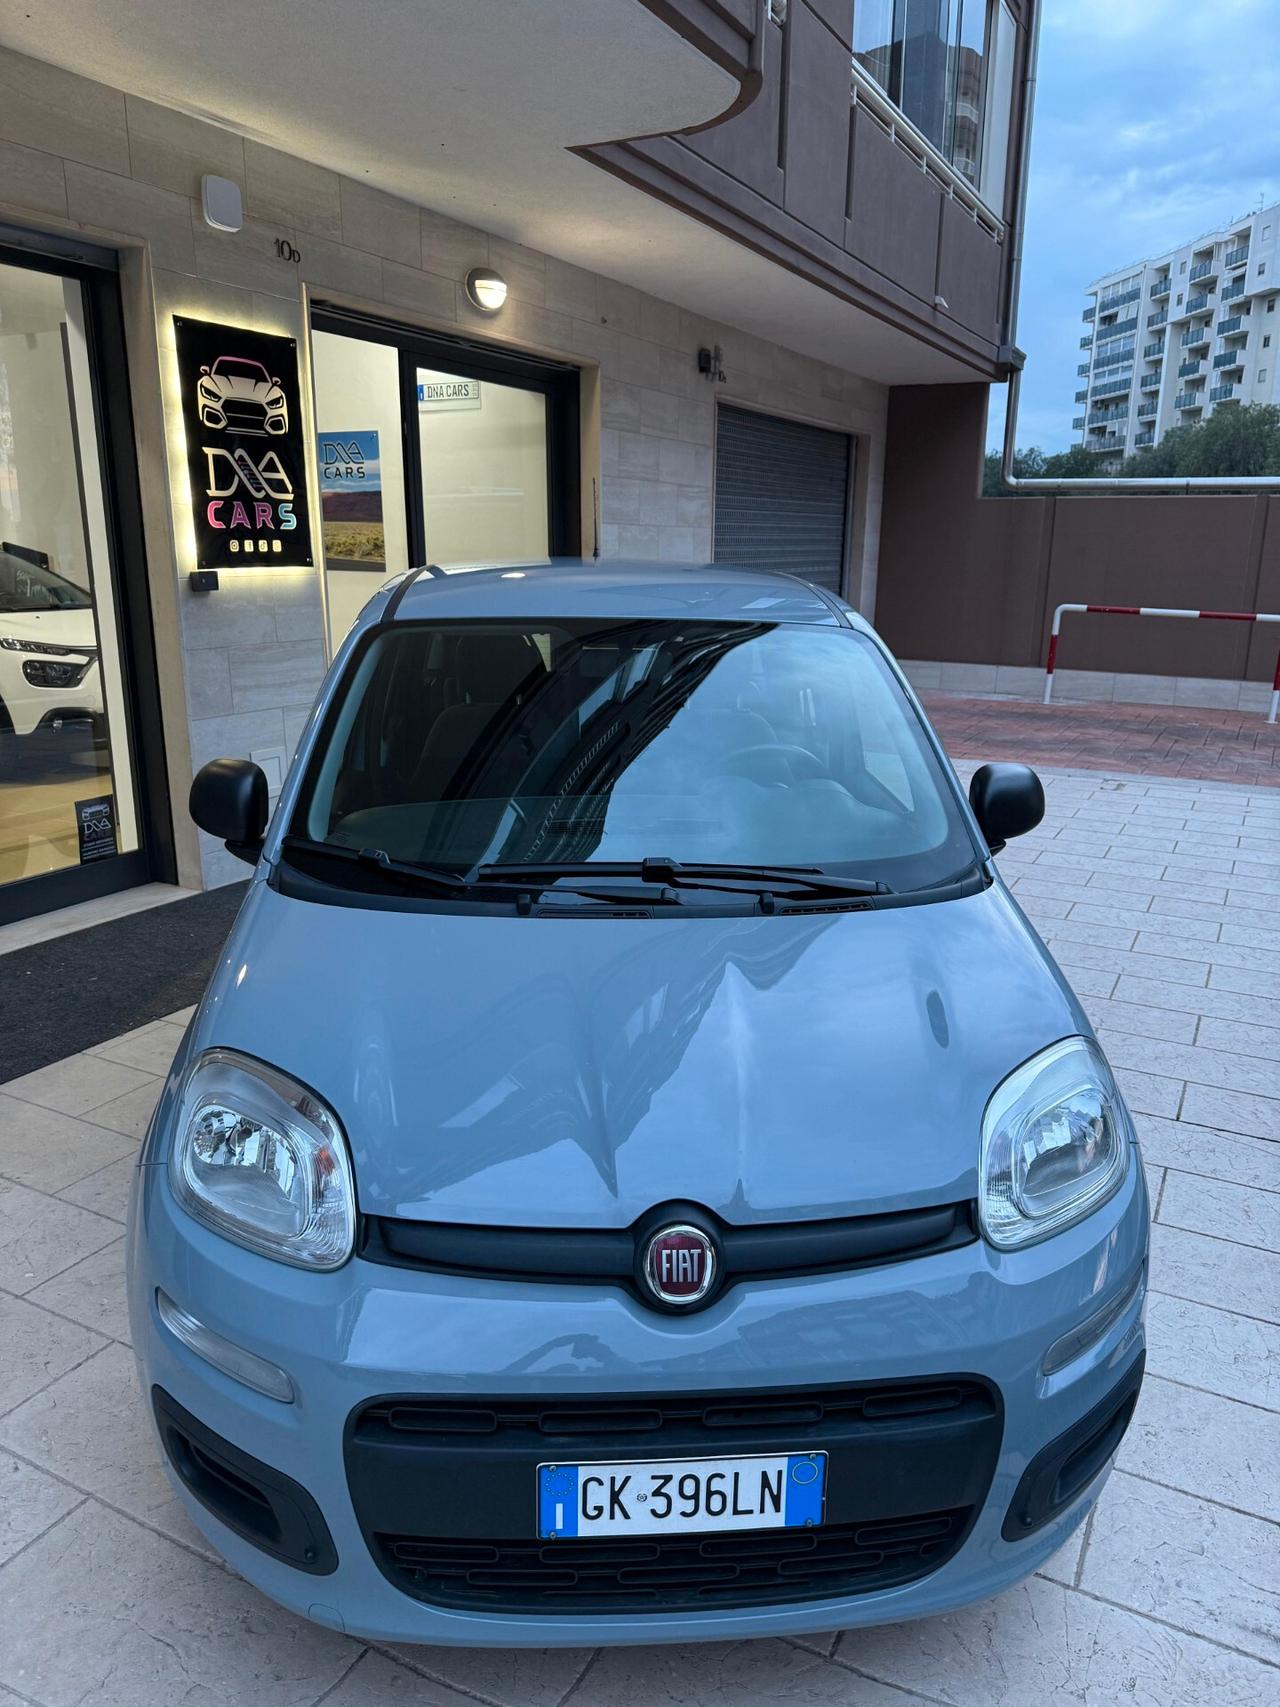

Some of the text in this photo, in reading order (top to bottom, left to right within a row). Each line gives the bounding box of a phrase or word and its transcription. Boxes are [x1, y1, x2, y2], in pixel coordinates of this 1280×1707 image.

[427, 386, 444, 398] DNA
[446, 384, 469, 398] CARS
[323, 441, 364, 465] DNA
[202, 447, 294, 500] DNA
[323, 466, 366, 479] CARS
[207, 501, 297, 530] CARS
[661, 1249, 702, 1282] FIAT
[581, 1475, 632, 1520] GK
[650, 1469, 783, 1519] 396LN
